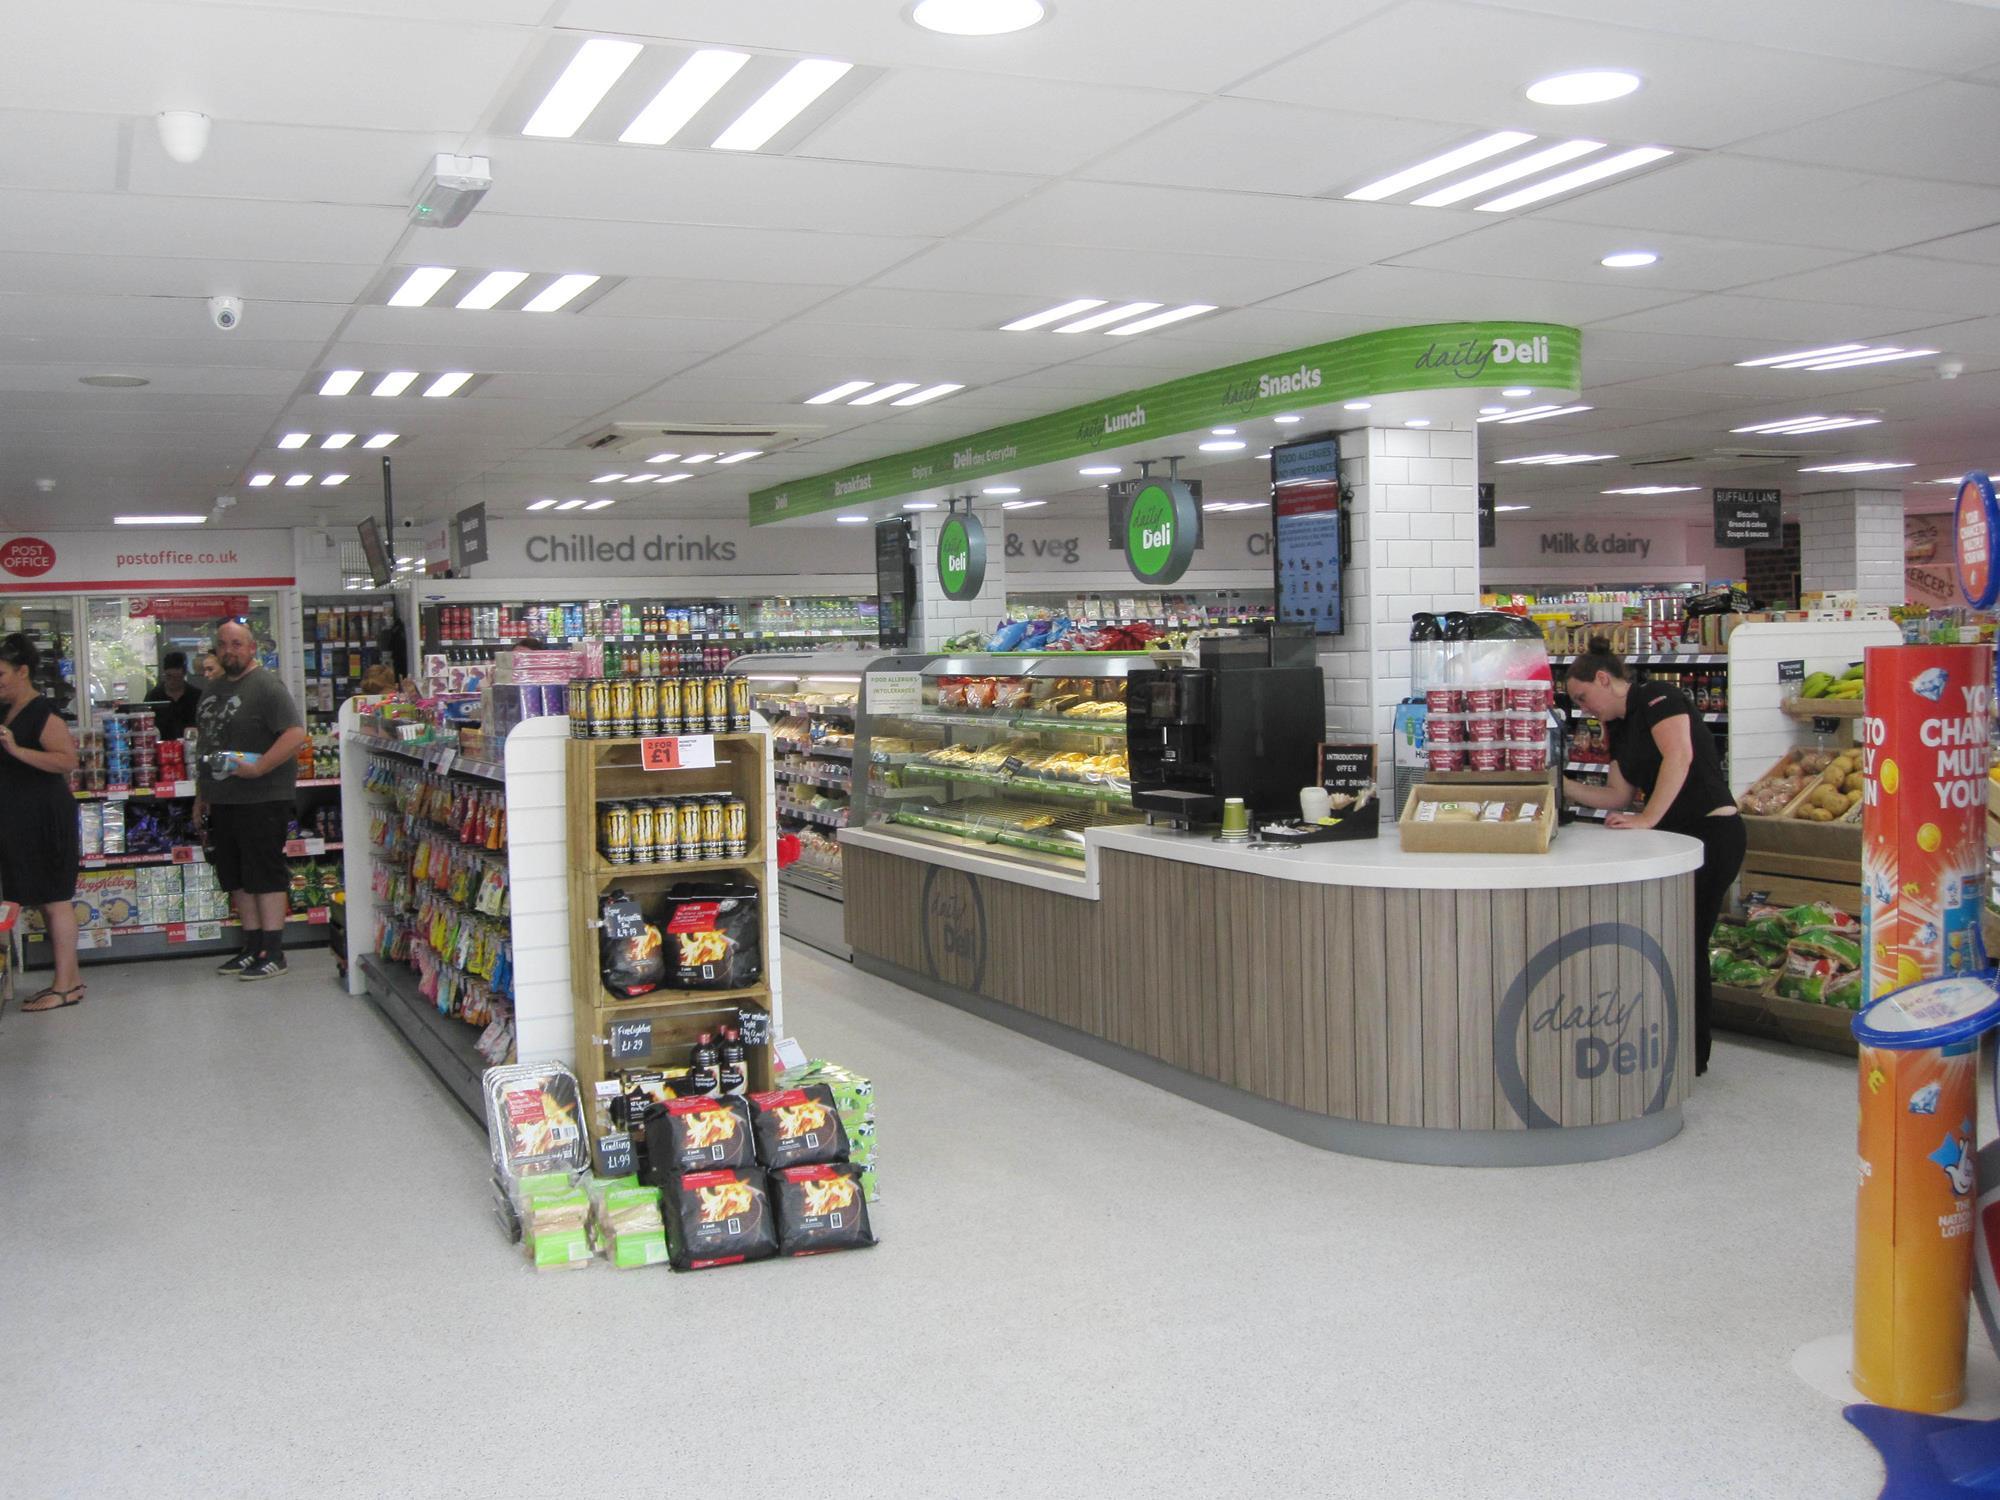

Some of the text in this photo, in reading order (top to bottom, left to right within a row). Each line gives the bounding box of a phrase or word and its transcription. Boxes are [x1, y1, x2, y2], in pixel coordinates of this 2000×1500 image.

[1415, 335, 1548, 379] daily Deli
[1258, 365, 1322, 398] Snacks
[1104, 404, 1146, 433] Lunch
[953, 447, 972, 469] Deli
[834, 474, 872, 497] Breakfast
[1143, 522, 1171, 549] Deli
[1541, 532, 1651, 558] Milk & dairy
[11, 545, 45, 557] POST
[117, 550, 238, 568] postoffice.co.uk
[525, 534, 737, 563] Chilled drinks
[1032, 537, 1080, 564] veg
[4, 556, 50, 568] OFFICE
[949, 552, 966, 572] Deli
[1920, 717, 1990, 747] CHAN
[648, 741, 672, 750] 2 FOR
[651, 749, 671, 763] £1
[1326, 753, 1368, 761] INTRODUCTORY
[1533, 987, 1643, 1047] daily
[1575, 1023, 1659, 1079] Deli
[601, 1140, 631, 1154] Kindling
[607, 1154, 631, 1169] £1.99
